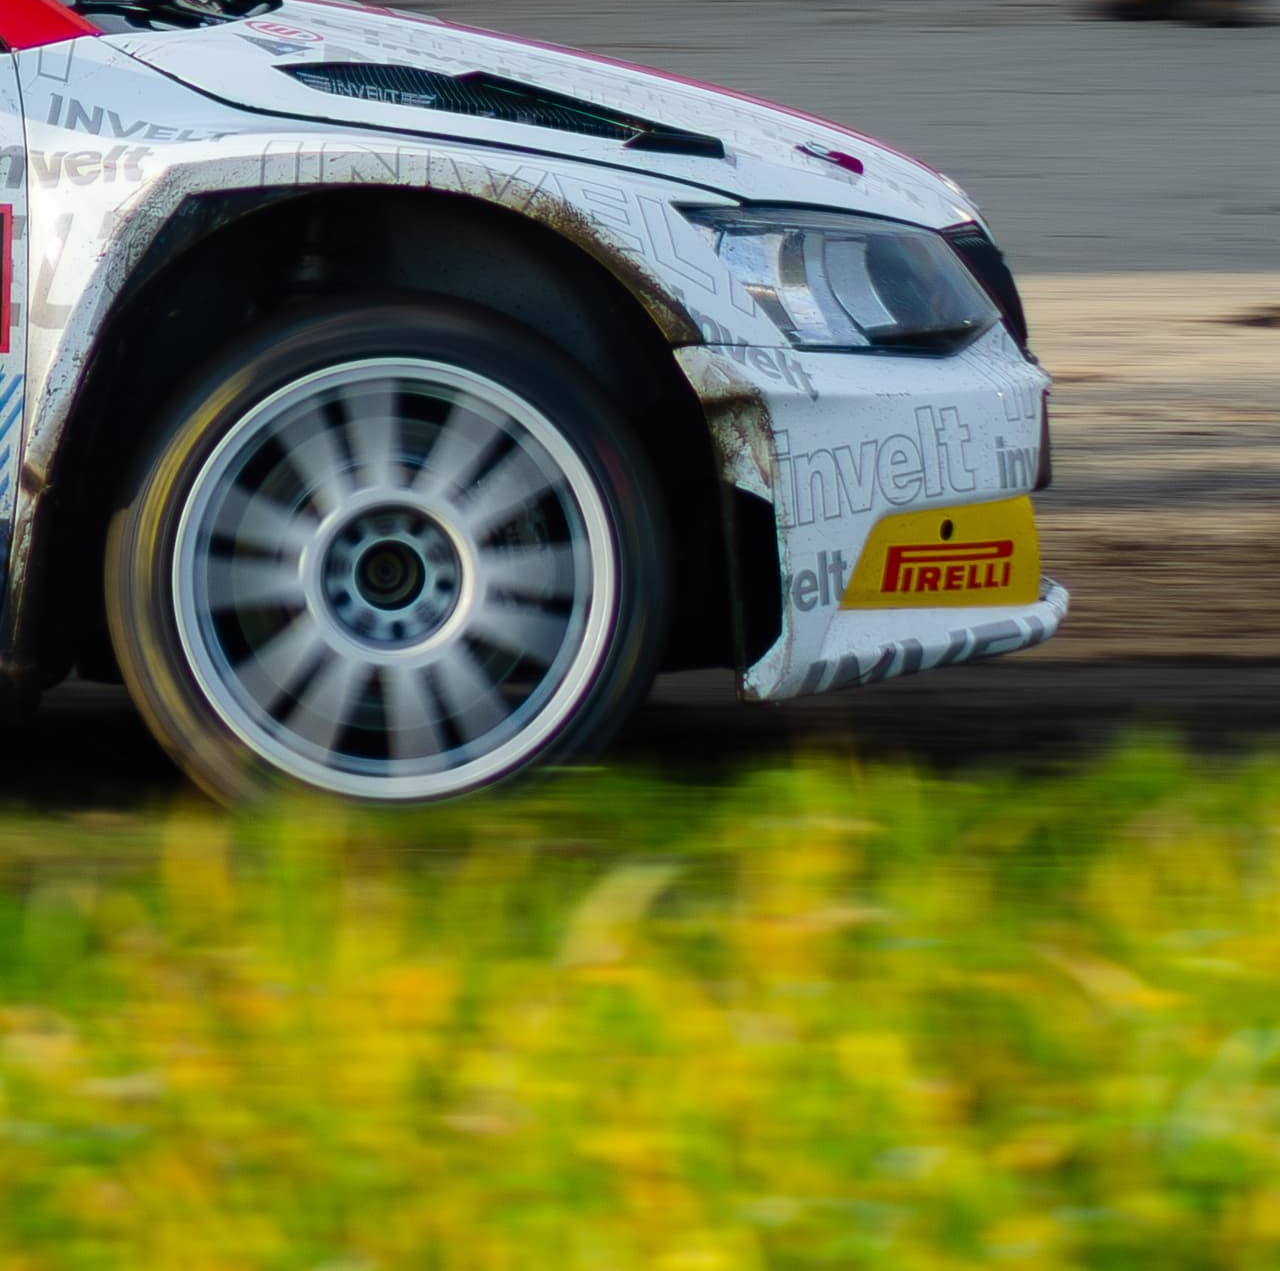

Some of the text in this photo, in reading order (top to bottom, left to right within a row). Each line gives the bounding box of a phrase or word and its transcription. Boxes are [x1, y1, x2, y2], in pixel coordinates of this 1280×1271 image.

[47, 91, 242, 143] INVELT
[773, 405, 977, 529] invelt
[880, 539, 1015, 594] PIRELLI
